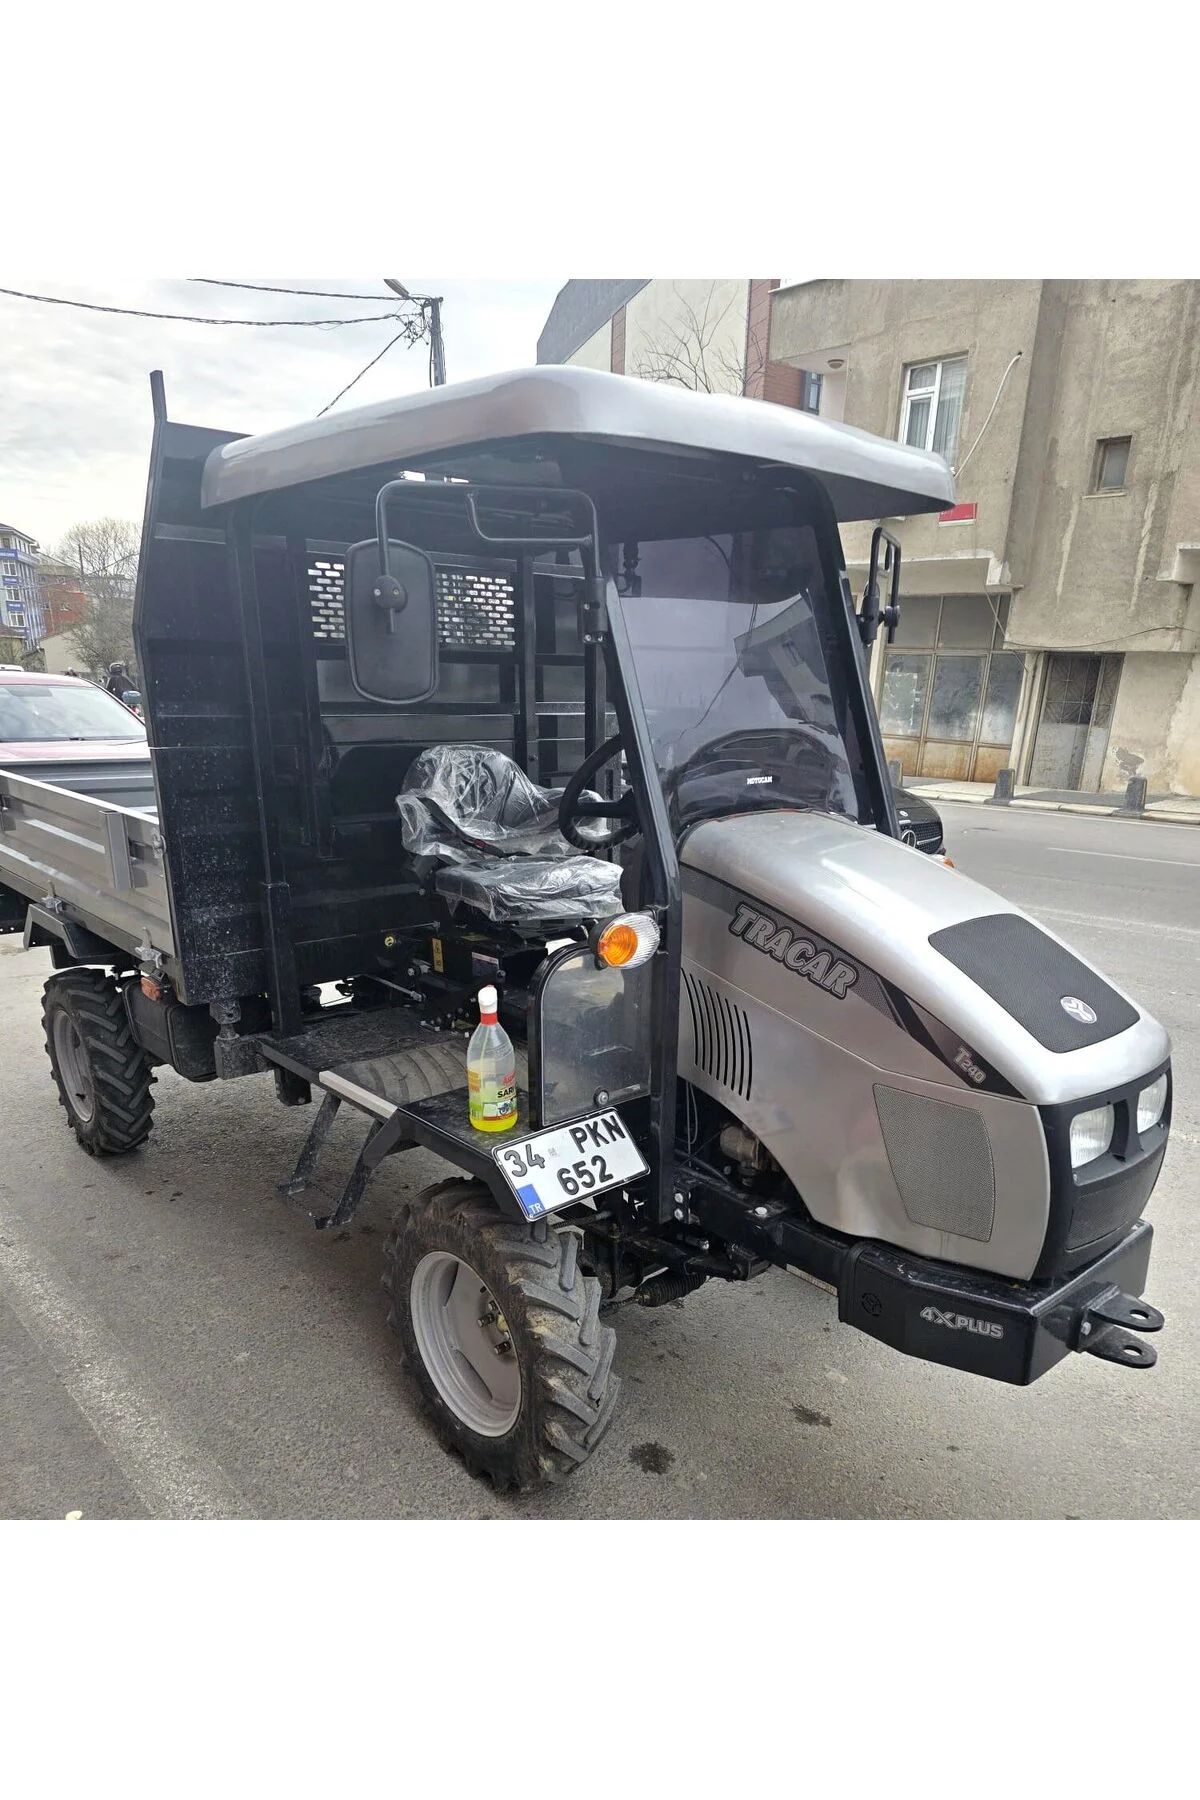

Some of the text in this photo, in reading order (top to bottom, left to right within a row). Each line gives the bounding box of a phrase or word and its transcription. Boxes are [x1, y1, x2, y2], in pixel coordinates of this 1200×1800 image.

[729, 902, 859, 1000] TRACAR
[954, 1046, 987, 1084] T240
[504, 1115, 626, 1177] 34 PKN
[556, 1155, 614, 1195] 652
[528, 1202, 543, 1214] TR
